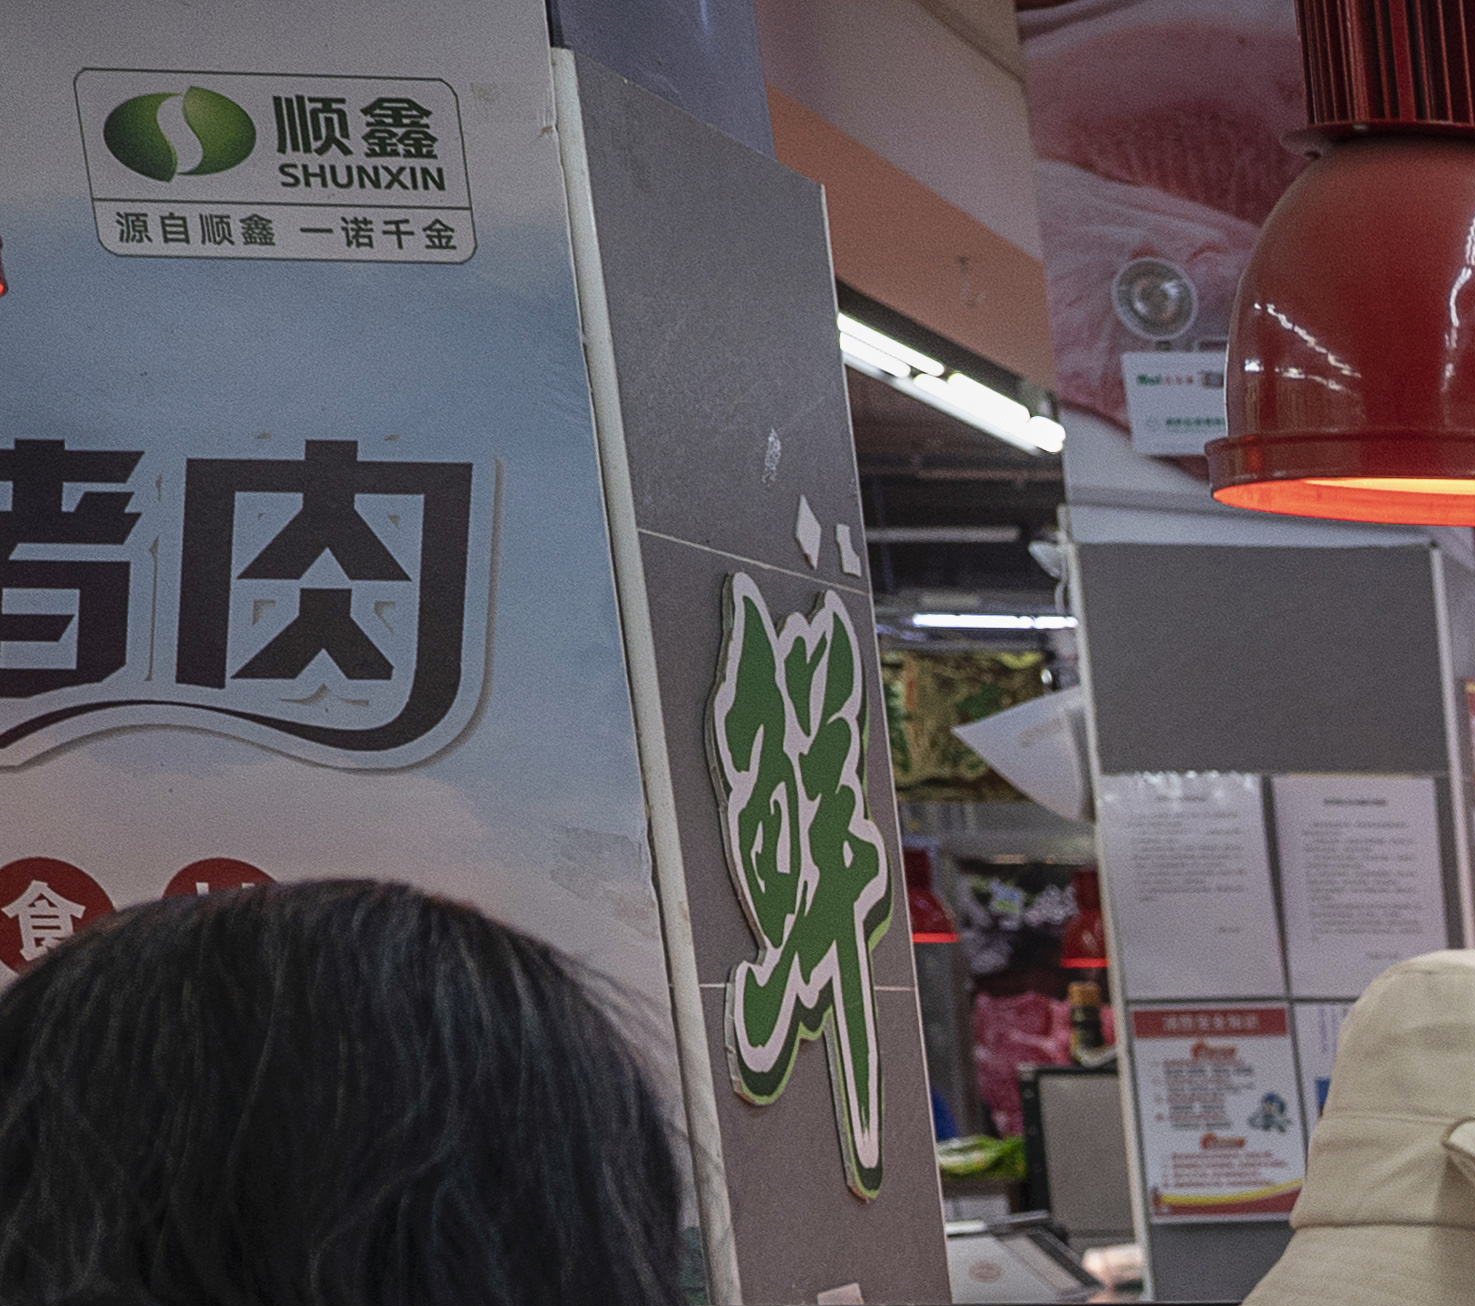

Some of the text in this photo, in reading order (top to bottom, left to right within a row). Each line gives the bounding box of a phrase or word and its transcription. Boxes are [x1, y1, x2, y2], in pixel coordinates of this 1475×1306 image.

[273, 95, 440, 161] 顺鑫
[278, 163, 446, 191] SHUNXIN
[116, 211, 457, 251] 源自顺鑫 一诺千金
